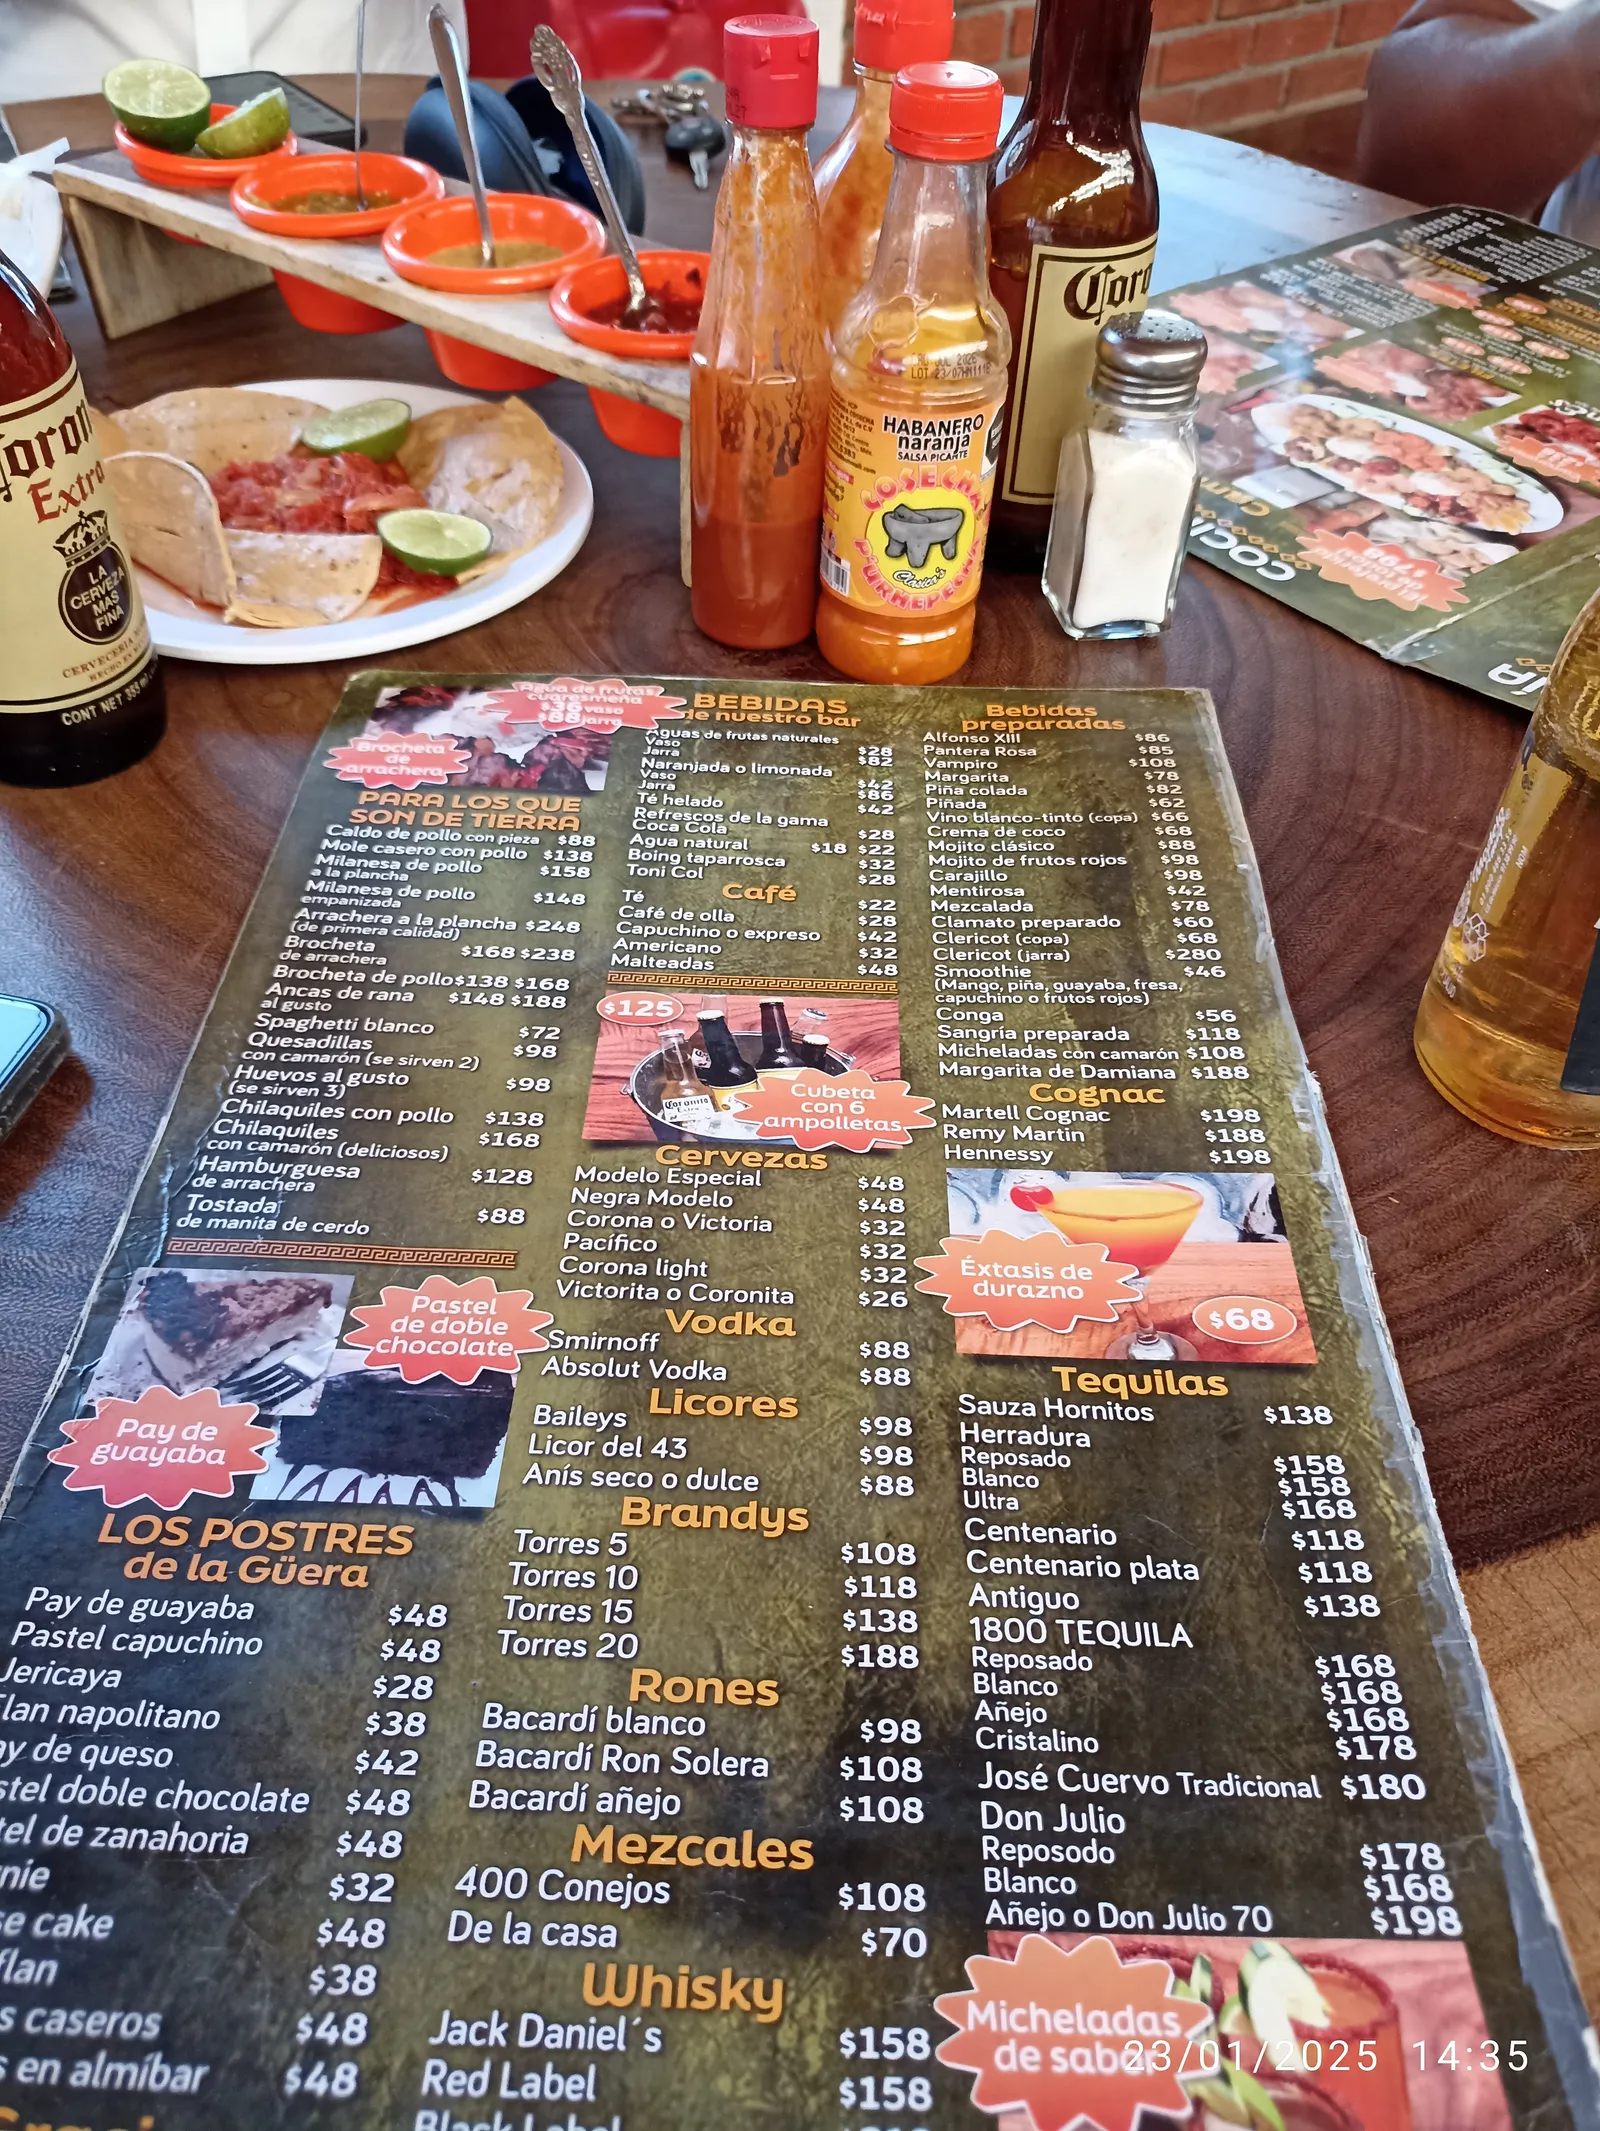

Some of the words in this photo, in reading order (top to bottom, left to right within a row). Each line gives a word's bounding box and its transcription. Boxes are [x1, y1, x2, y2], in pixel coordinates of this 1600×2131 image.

[1064, 264, 1153, 325] Coro
[883, 413, 986, 436] HABANERO
[899, 434, 971, 452] naranja
[897, 451, 928, 462] SALSA
[930, 450, 969, 461] PICANTE
[27, 460, 105, 524] Extra
[861, 464, 985, 512] COSECHA
[1189, 515, 1295, 580] COCI
[88, 564, 107, 585] LA
[70, 566, 125, 610] CERVEZA
[92, 589, 120, 617] MAS
[96, 604, 125, 632] FINA
[572, 685, 595, 693] de
[61, 705, 97, 726] CONT
[100, 693, 123, 714] NET
[541, 701, 582, 712] $36
[584, 706, 624, 714] vaso
[693, 693, 848, 714] BEBIDAS
[986, 704, 1098, 718] Bebidas
[537, 712, 581, 723] $88
[580, 716, 622, 726] jarra
[684, 708, 710, 722] de
[716, 710, 812, 726] nuestro
[818, 712, 861, 728] bar
[962, 717, 1126, 733] preparadas
[356, 741, 446, 756] Brocheta
[646, 729, 700, 740] Aguas
[704, 730, 722, 740] de
[726, 730, 768, 741] frutas
[772, 733, 840, 744] naturales
[923, 732, 990, 744] Alfonso
[994, 732, 1021, 743] XIII
[1134, 734, 1170, 744] $86
[346, 764, 444, 777] arrachera
[384, 754, 411, 765] de
[924, 758, 998, 771] Vampiro
[1128, 758, 1176, 769] $108
[359, 791, 444, 808] PARA
[451, 794, 509, 810] LOS
[516, 796, 581, 813] QUE
[349, 809, 415, 826] SON
[422, 811, 464, 827] DE
[471, 813, 580, 831] TIERRA
[722, 883, 798, 904] Café
[290, 920, 316, 933] (de
[321, 923, 388, 938] primera
[392, 927, 460, 941] calidad)
[294, 908, 393, 925] Arrachera
[398, 915, 410, 925] a
[416, 914, 434, 926] la
[439, 915, 517, 931] plancha
[525, 920, 581, 934] $248
[616, 921, 720, 940] Capuchino
[726, 928, 740, 939] o
[744, 929, 821, 942] expreso
[857, 931, 897, 943] $42
[610, 954, 715, 971] Malteadas
[857, 964, 898, 977] $48
[934, 964, 1032, 979] Smoothie
[1183, 966, 1226, 979] $46
[934, 979, 1004, 993] (Mango,
[1007, 979, 1050, 993] piña,
[1053, 980, 1131, 993] guayaba,
[1134, 978, 1183, 993] fresa,
[604, 1000, 675, 1018] $125
[935, 992, 1024, 1005] capuchino
[1028, 994, 1040, 1005] o
[1044, 992, 1095, 1005] frutos
[1099, 992, 1150, 1006] rojos)
[938, 1044, 1058, 1060] Micheladas
[1063, 1049, 1095, 1060] con
[1099, 1047, 1179, 1061] camarón
[1186, 1046, 1245, 1061] $108
[791, 1083, 877, 1100] Cubeta
[1029, 1083, 1166, 1108] Cognac
[801, 1101, 844, 1115] con
[849, 1100, 865, 1115] 6
[764, 1115, 902, 1134] ampolletas
[655, 1144, 829, 1171] Cervezas
[199, 1156, 361, 1181] Hamburguesa
[471, 1168, 533, 1186] $128
[960, 1255, 1056, 1280] Éxtasis
[1061, 1259, 1093, 1281] de
[973, 1280, 1084, 1301] durazno
[411, 1295, 498, 1316] Pastel
[390, 1316, 428, 1335] de
[432, 1316, 509, 1337] doble
[664, 1308, 797, 1338] Vodka
[1208, 1307, 1275, 1332] $68
[375, 1335, 514, 1359] chocolate
[1051, 1365, 1229, 1401] Tequilas
[648, 1388, 799, 1419] Licores
[116, 1418, 177, 1443] Pay
[181, 1421, 218, 1442] de
[533, 1404, 628, 1429] Baileys
[859, 1417, 913, 1437] $98
[90, 1442, 226, 1467] guayaba
[620, 1495, 810, 1538] Brandys
[98, 1512, 192, 1547] LOS
[200, 1518, 415, 1557] POSTRES
[123, 1553, 175, 1581] de
[187, 1553, 229, 1582] la
[238, 1554, 369, 1589] Güera
[969, 1616, 1048, 1646] 1800
[1055, 1618, 1194, 1650] TEQUILA
[0, 1657, 123, 1694] Jericaya
[372, 1674, 435, 1701] $28
[628, 1667, 780, 1708] Rones
[57, 1699, 221, 1732] napolitano
[364, 1711, 427, 1738] $38
[481, 1701, 599, 1734] Bacardí
[606, 1706, 706, 1738] blanco
[860, 1718, 923, 1745] $98
[977, 1760, 1050, 1793] José
[1057, 1763, 1170, 1797] Cuervo
[1175, 1771, 1323, 1800] Tradicional
[1340, 1773, 1427, 1801] $180
[570, 1822, 815, 1872] Mezcales
[981, 1835, 1117, 1868] Reposodo
[1359, 1842, 1446, 1872] $178
[454, 1866, 529, 1901] 400
[537, 1868, 671, 1910] Conejos
[838, 1882, 927, 1913] $108
[582, 1961, 785, 2025] Whisky
[966, 1999, 1183, 2037] Micheladas
[429, 2008, 508, 2048] Jack
[838, 2027, 932, 2062] $158
[993, 2041, 1042, 2072] de
